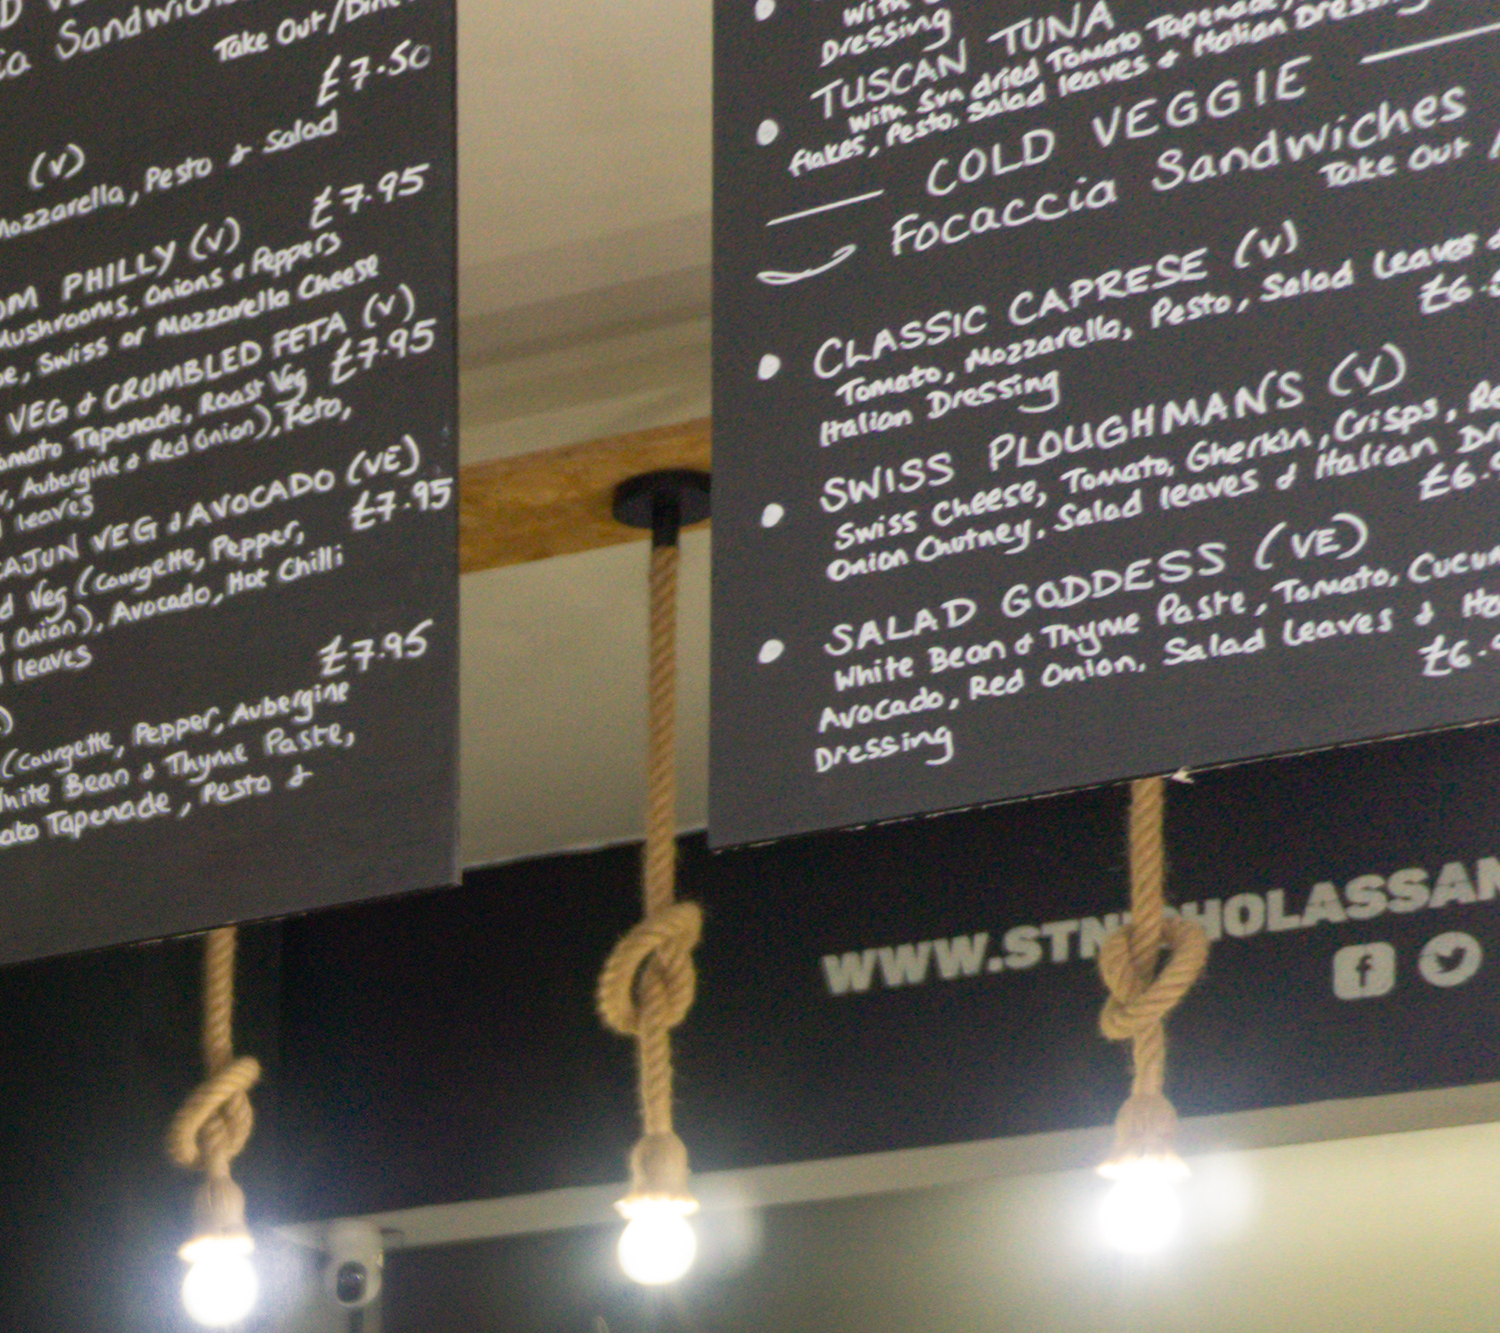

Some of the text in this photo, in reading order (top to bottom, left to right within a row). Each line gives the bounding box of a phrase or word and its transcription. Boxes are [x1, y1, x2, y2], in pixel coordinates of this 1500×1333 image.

[810, 0, 1115, 119] TUSCAN TUNA
[821, 4, 952, 67] Dressing
[891, 82, 1470, 256] Focaccia Sandwiches
[926, 52, 1312, 196] COLD VEGGIE
[62, 240, 177, 301] PHILLY
[309, 162, 430, 230] £7.95
[8, 398, 69, 434] VEG
[103, 340, 265, 415] CRUMBLED
[272, 311, 347, 357] FETA
[813, 304, 987, 383] CLASSIC
[1008, 247, 1208, 329] CAPRESE
[92, 515, 158, 551] VEG
[185, 468, 336, 528] AVOCADO
[819, 451, 955, 513] SWISS
[824, 597, 977, 656] SALAD
[1001, 542, 1232, 622] GODDESS
[814, 725, 955, 773] Dressing
